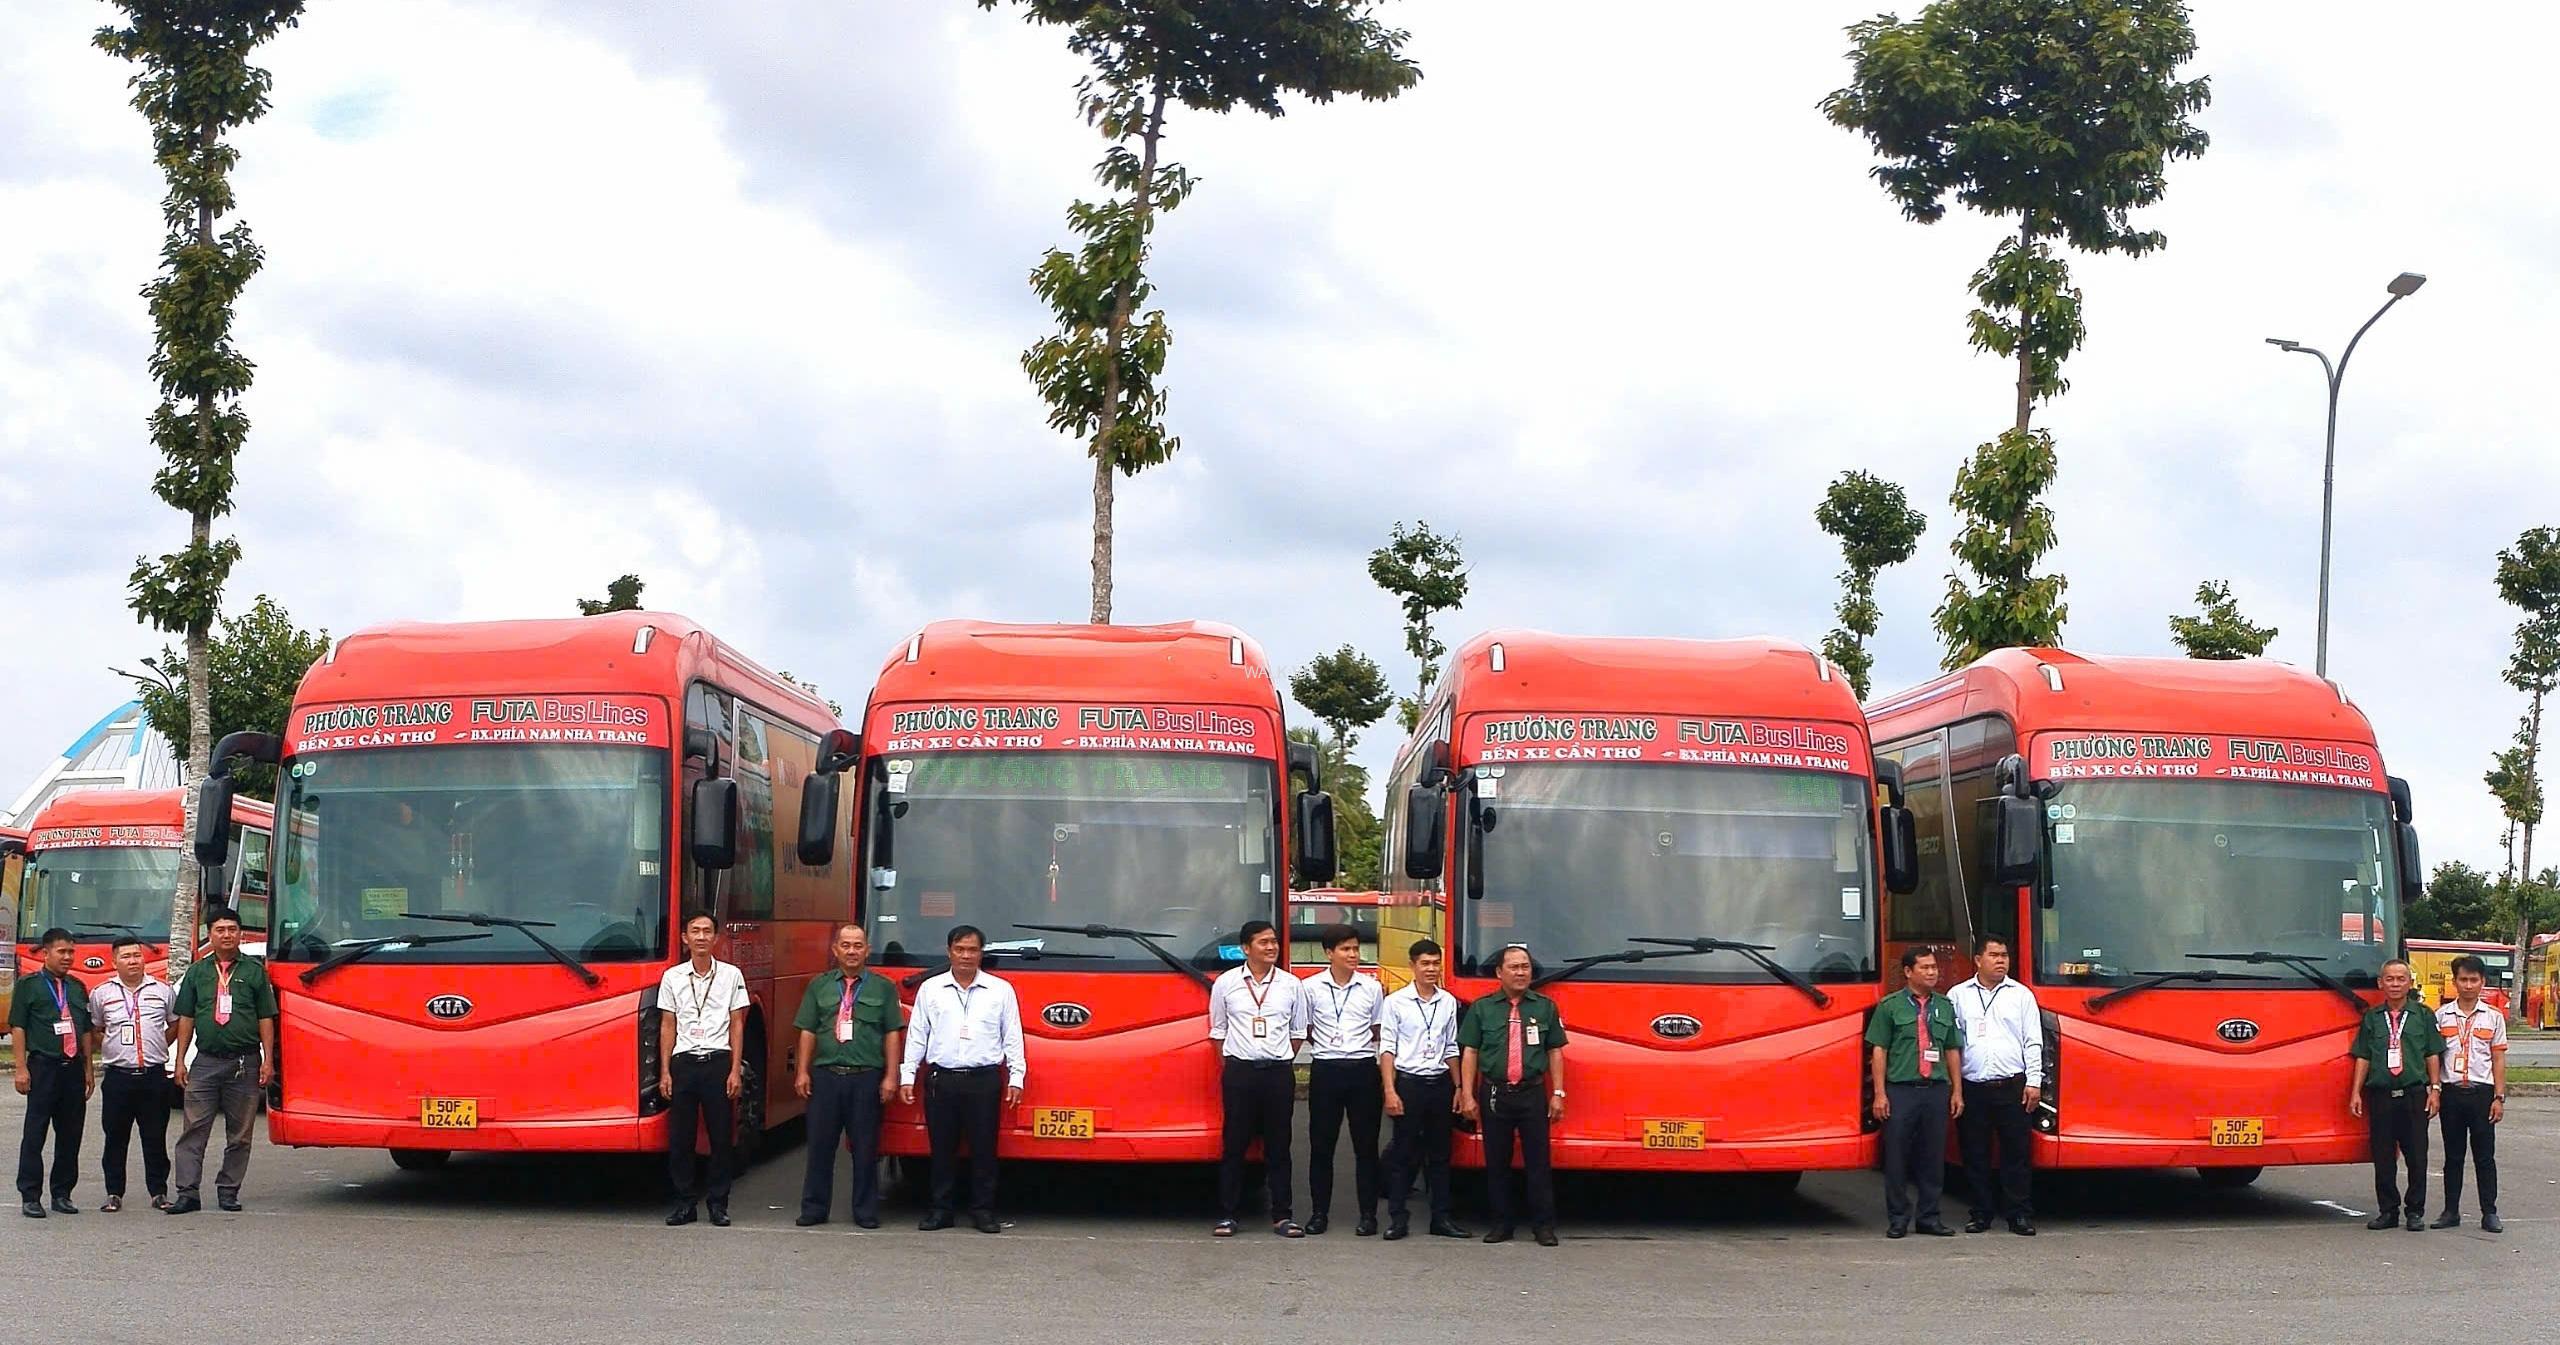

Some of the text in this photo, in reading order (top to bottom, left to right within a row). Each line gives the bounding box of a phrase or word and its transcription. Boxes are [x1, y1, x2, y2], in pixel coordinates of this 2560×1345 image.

[303, 700, 648, 734] PHƯƠNG TRANG FUTA Bus Lines
[892, 705, 1256, 737] PHƯƠNG TRANG FUTA Bus Lines
[297, 734, 329, 751] BẾN
[332, 736, 355, 748] XE
[358, 729, 397, 745] CẦN
[400, 729, 437, 743] THƠ
[529, 728, 561, 741] NAM
[564, 728, 594, 741] NHA
[598, 729, 648, 743] TRANG
[887, 735, 924, 751] BẾN
[928, 737, 953, 749] XE
[956, 731, 999, 748] CẦN
[1005, 735, 1043, 748] THƠ
[1139, 737, 1171, 750] NAM
[1174, 738, 1205, 750] NHA
[1208, 740, 1256, 754] TRANG
[1483, 714, 1849, 755] PHƯƠNG TRANG FUTA Bus Lines
[1480, 744, 1519, 761] BẾN
[1524, 747, 1551, 760] XE
[1555, 742, 1597, 759] CẦN
[1602, 746, 1643, 759] THƠ
[1740, 752, 1772, 765] NAM
[1774, 754, 1802, 767] NHA
[1805, 756, 1850, 771] TRANG
[2051, 734, 2371, 773] PHƯƠNG TRANG FUTA Bus Lines
[2050, 762, 2087, 778] BẾN
[2091, 765, 2116, 777] XE
[2119, 760, 2160, 776] CẦN
[2162, 763, 2199, 776] THƠ
[2283, 770, 2309, 782] NAM
[2310, 771, 2336, 784] NHA
[2337, 774, 2373, 788] TRANG
[71, 827, 102, 839] TRANG
[109, 827, 140, 839] FUTA
[86, 958, 102, 968] KIA
[433, 1000, 467, 1015] KIA
[1049, 1007, 1083, 1024] KIA
[1658, 1017, 1696, 1034] KIA
[2224, 1022, 2254, 1038] KIA
[436, 1100, 462, 1114] 50F
[427, 1113, 472, 1128] 024.44
[1050, 1110, 1077, 1123] 50F
[1039, 1123, 1088, 1138] 024.82
[2226, 1120, 2249, 1133] 50F
[2216, 1133, 2258, 1146] 030.23
